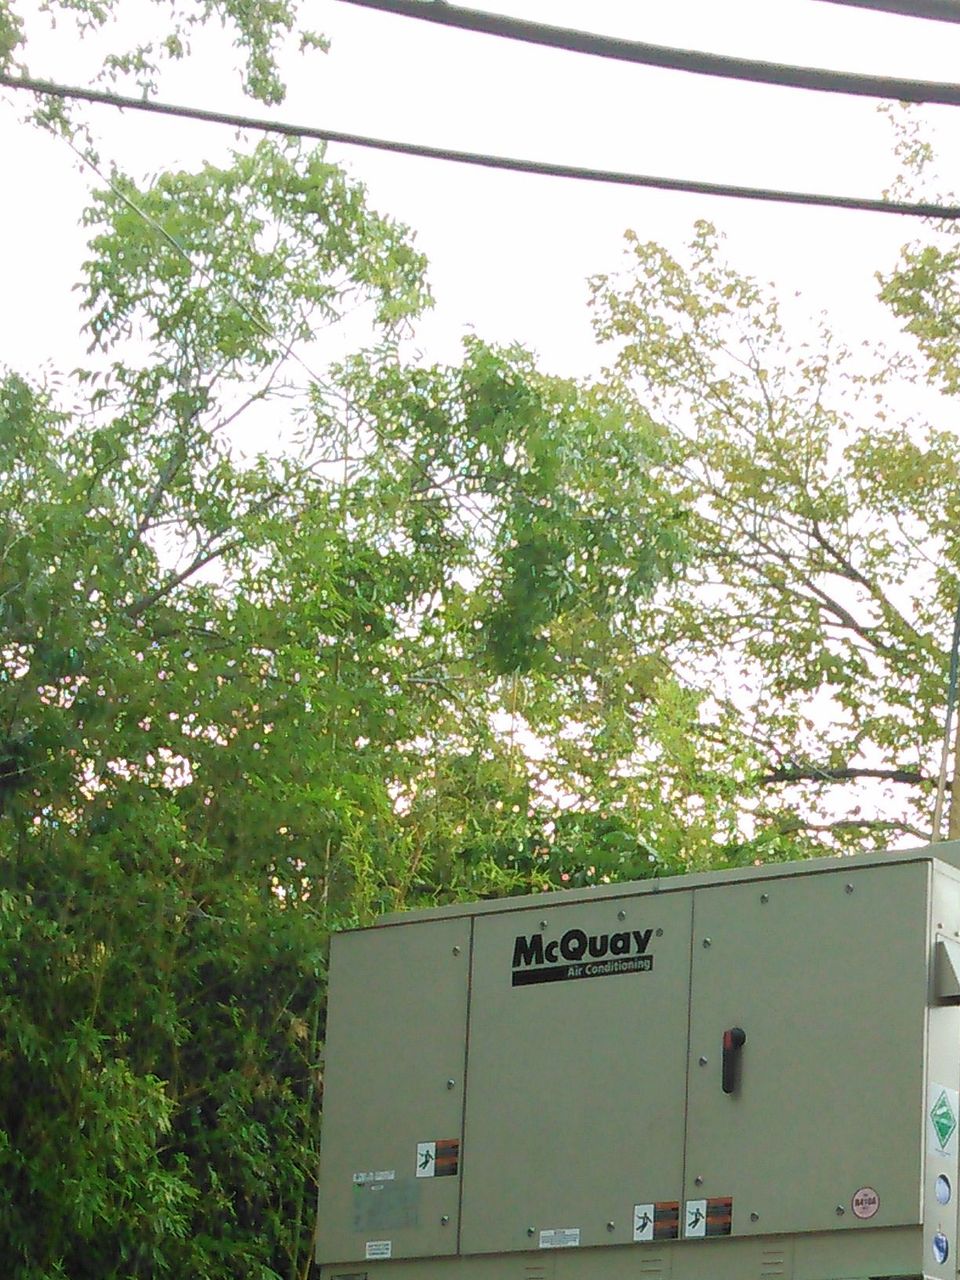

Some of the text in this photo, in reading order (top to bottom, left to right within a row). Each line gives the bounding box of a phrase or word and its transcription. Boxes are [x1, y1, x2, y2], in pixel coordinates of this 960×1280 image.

[512, 929, 653, 968] McQuay
[567, 959, 651, 977] Air Conditioning
